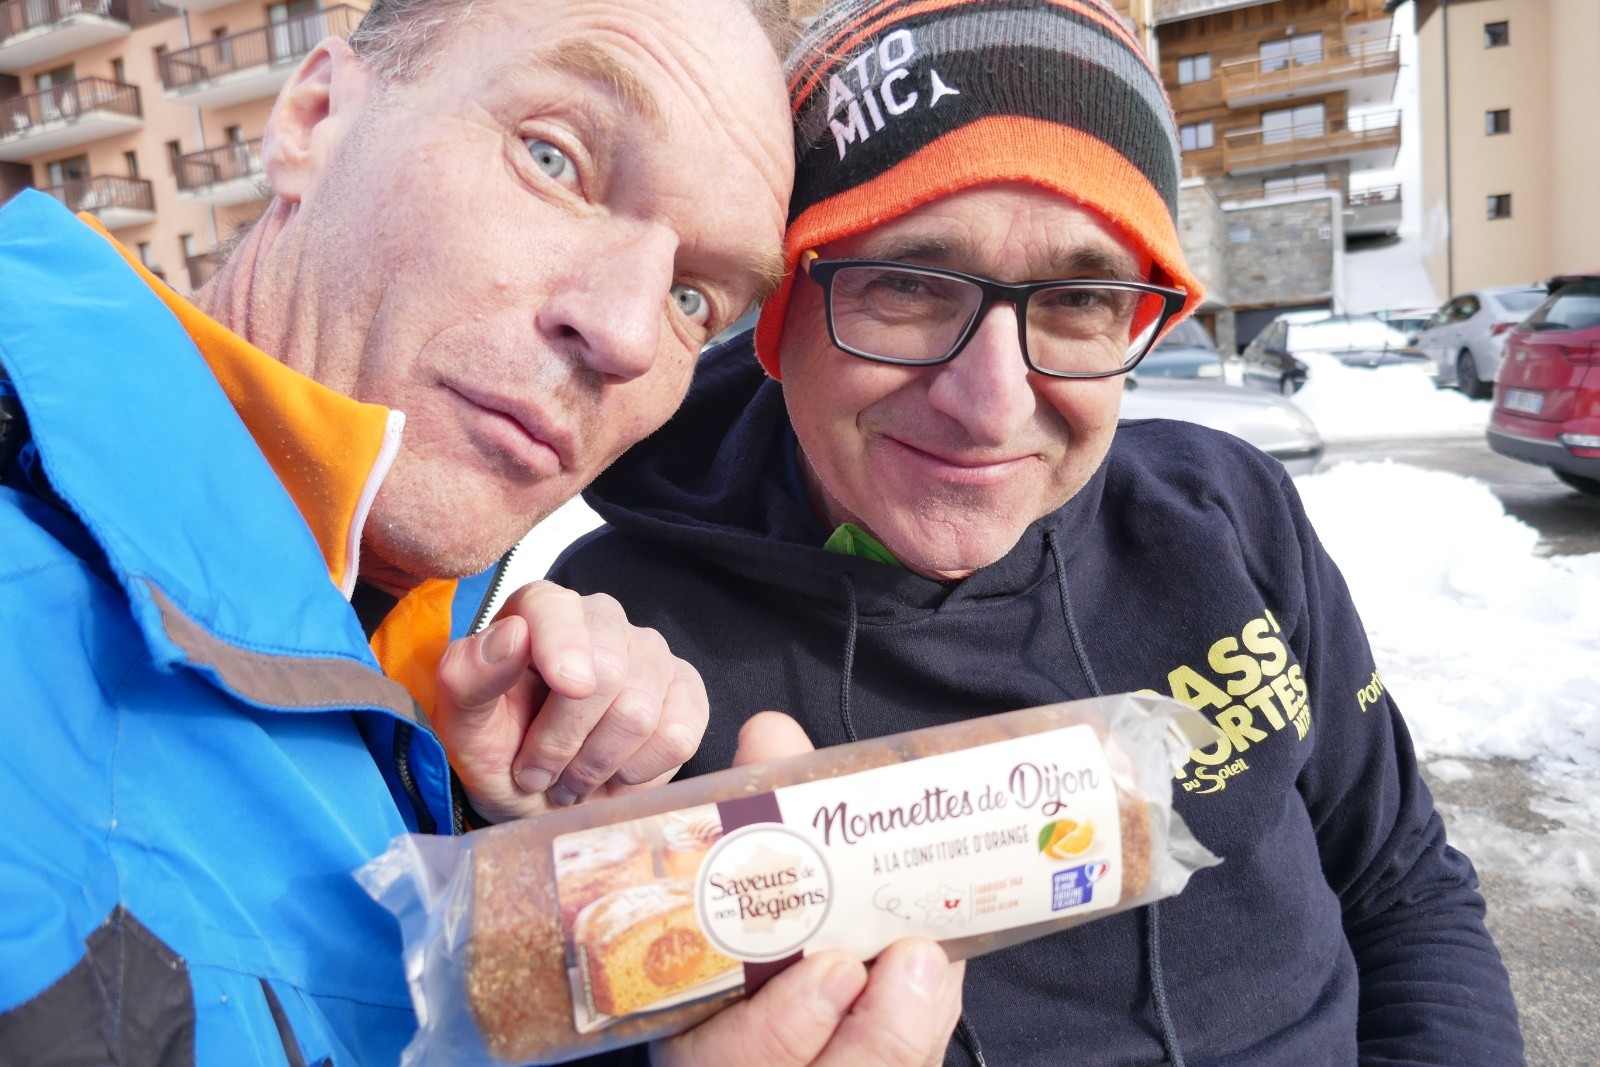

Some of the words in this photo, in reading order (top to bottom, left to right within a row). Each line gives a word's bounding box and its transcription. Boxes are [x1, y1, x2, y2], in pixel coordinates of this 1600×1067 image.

[827, 29, 915, 122] ATO
[829, 68, 918, 161] MIC
[1135, 609, 1287, 711] ASS'
[1175, 664, 1307, 779] ORTES
[812, 786, 974, 846] Nonnettes
[978, 785, 1008, 812] de
[1009, 762, 1099, 817] Dijon
[884, 853, 901, 872] LA
[903, 836, 970, 868] CONFITURE
[973, 824, 1029, 853] D'ORANGE
[709, 867, 798, 899] Saveurs
[801, 864, 815, 878] de
[738, 887, 826, 920] Régions
